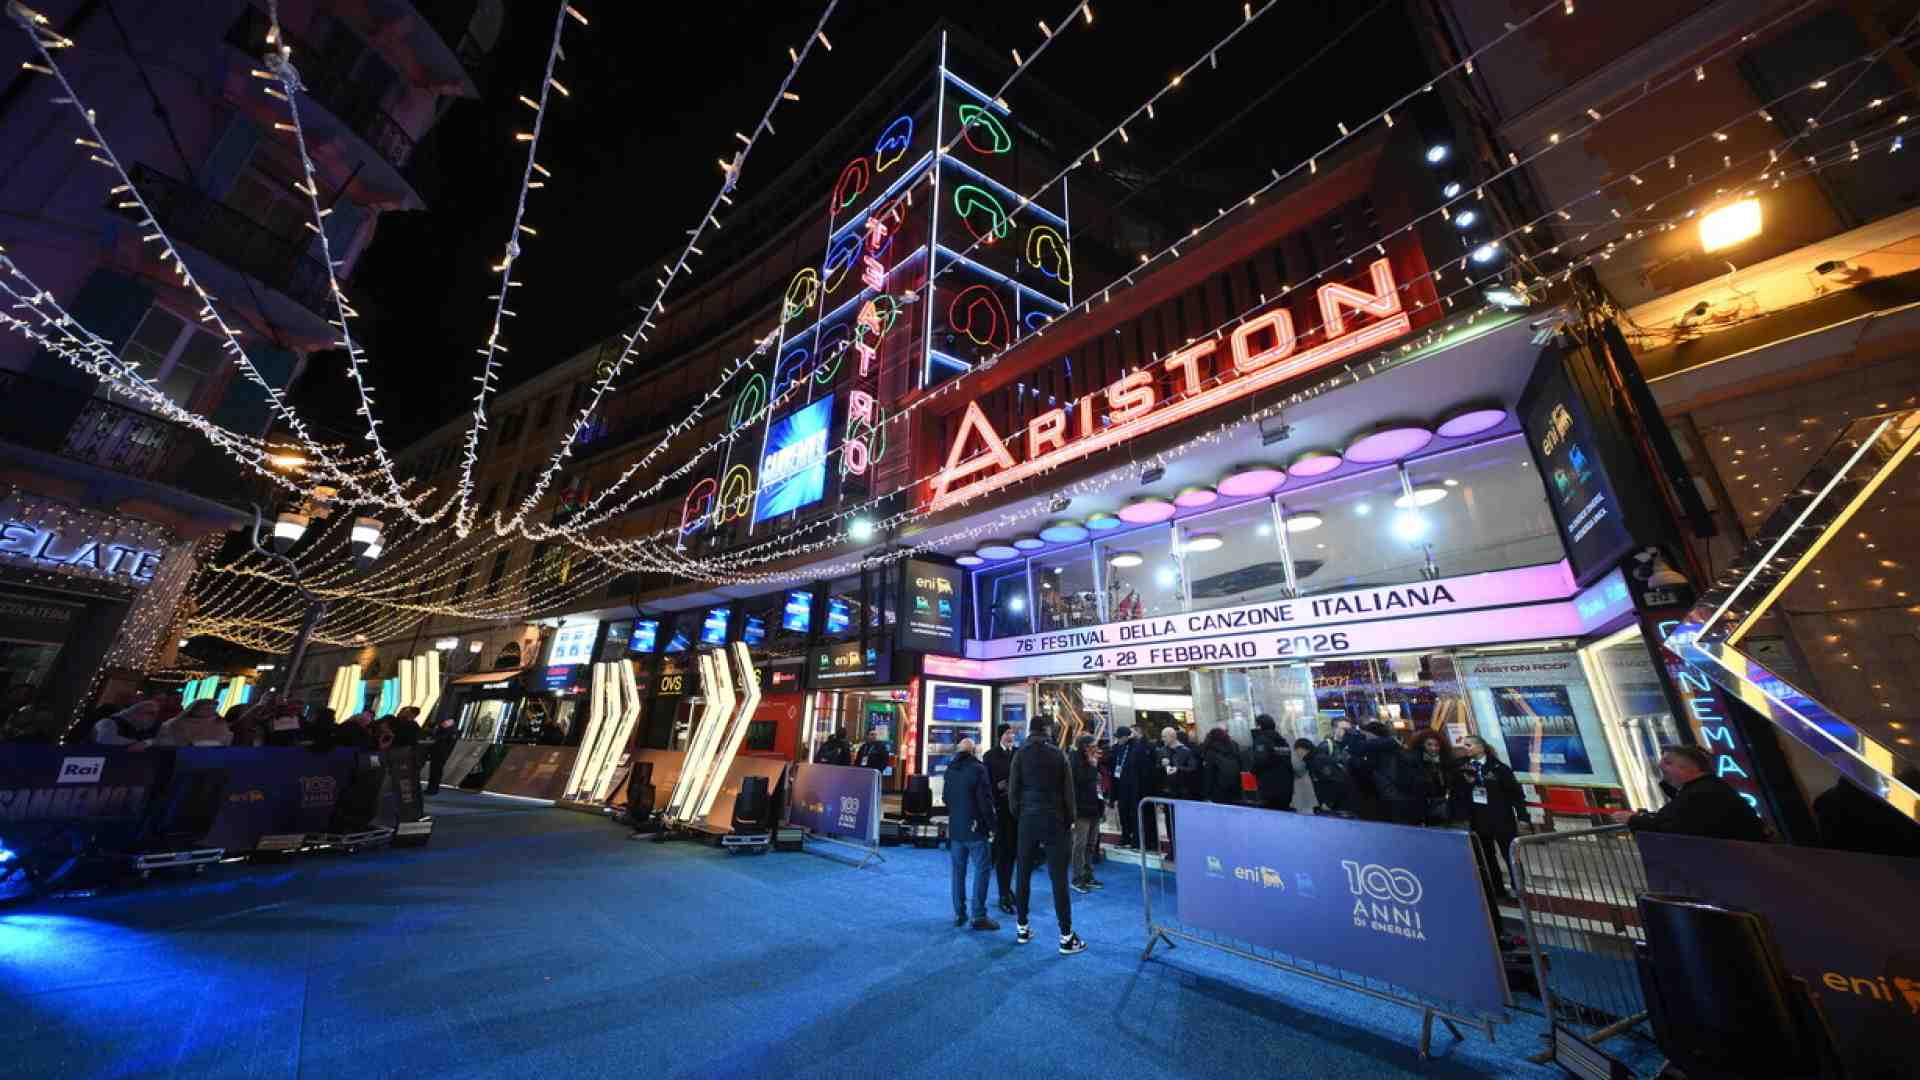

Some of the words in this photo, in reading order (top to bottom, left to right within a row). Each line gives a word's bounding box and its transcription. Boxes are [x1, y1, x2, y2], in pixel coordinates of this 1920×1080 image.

[930, 257, 1404, 513] ARISTON
[915, 577, 935, 591] eni
[1041, 629, 1109, 650] FESTIVAL
[1120, 620, 1176, 640] DELLA
[1188, 603, 1294, 632] CANZONE
[1312, 584, 1456, 618] ITALIANA
[1150, 641, 1257, 663] FEBBRAIO
[1276, 632, 1349, 655] 2026
[661, 675, 683, 691] OVS
[64, 763, 98, 775] Rai
[1233, 865, 1259, 882] eni
[1341, 860, 1423, 904] 100
[1353, 898, 1420, 930] ANNI
[1353, 916, 1366, 928] DI
[1371, 920, 1426, 941] ENERGIA
[1823, 970, 1895, 1002] eni
